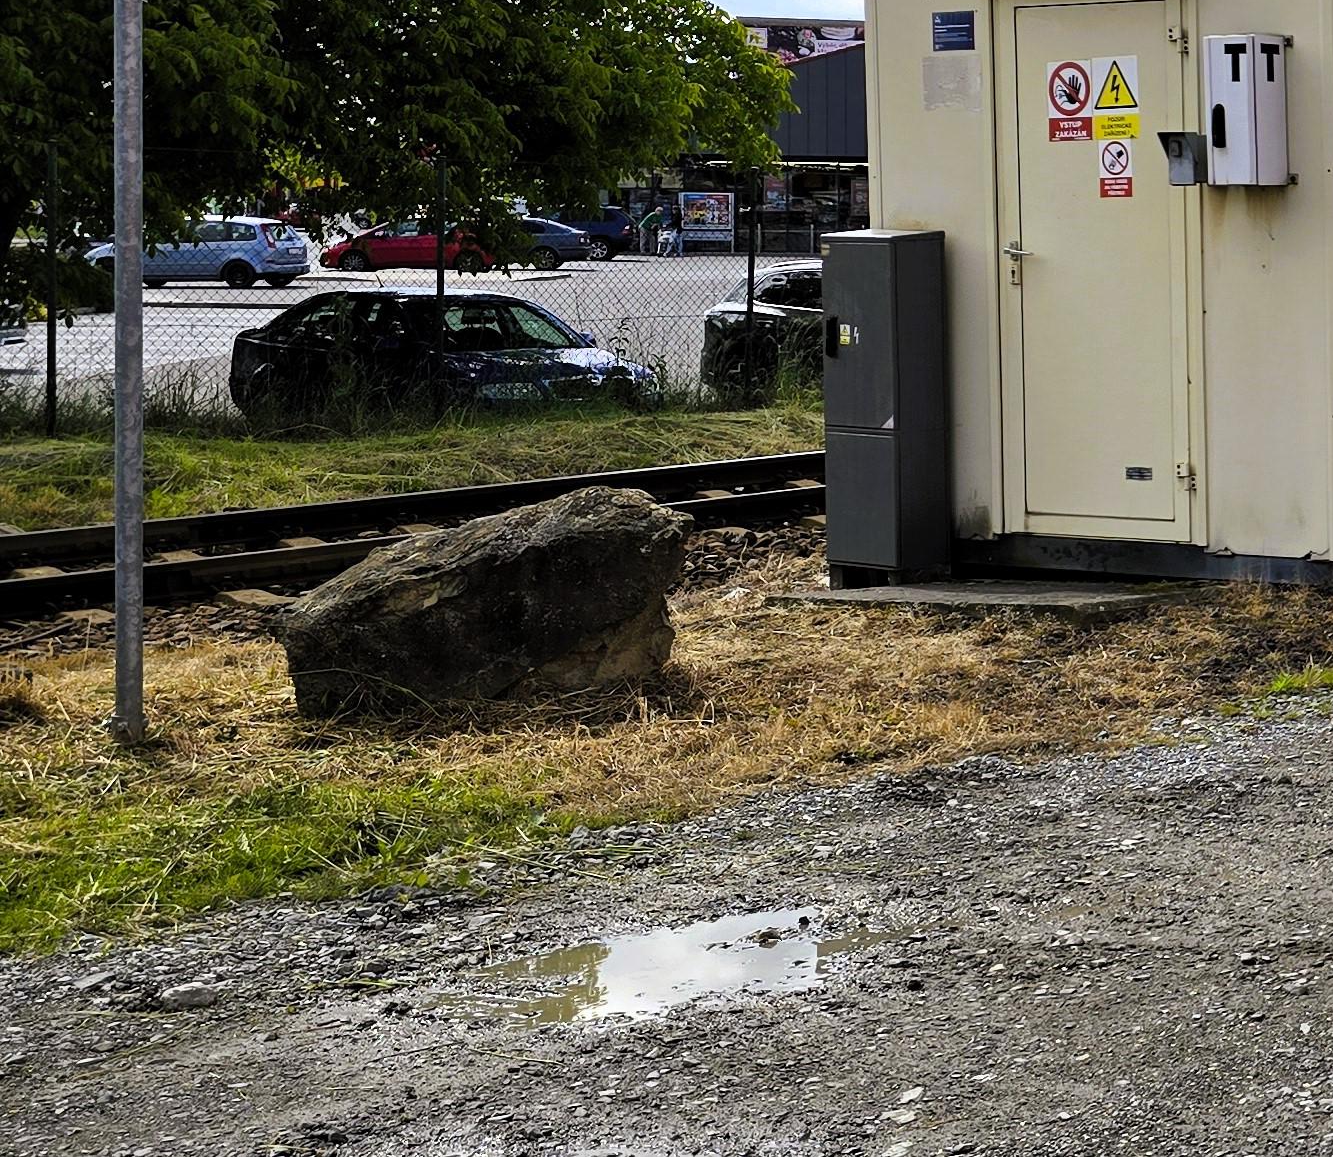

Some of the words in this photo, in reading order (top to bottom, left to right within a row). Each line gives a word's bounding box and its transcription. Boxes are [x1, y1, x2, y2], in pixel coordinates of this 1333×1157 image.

[1224, 43, 1247, 82] T
[1260, 43, 1280, 82] T
[1055, 129, 1088, 138] ZAKÁZÁN
[1059, 120, 1083, 129] VSTUP
